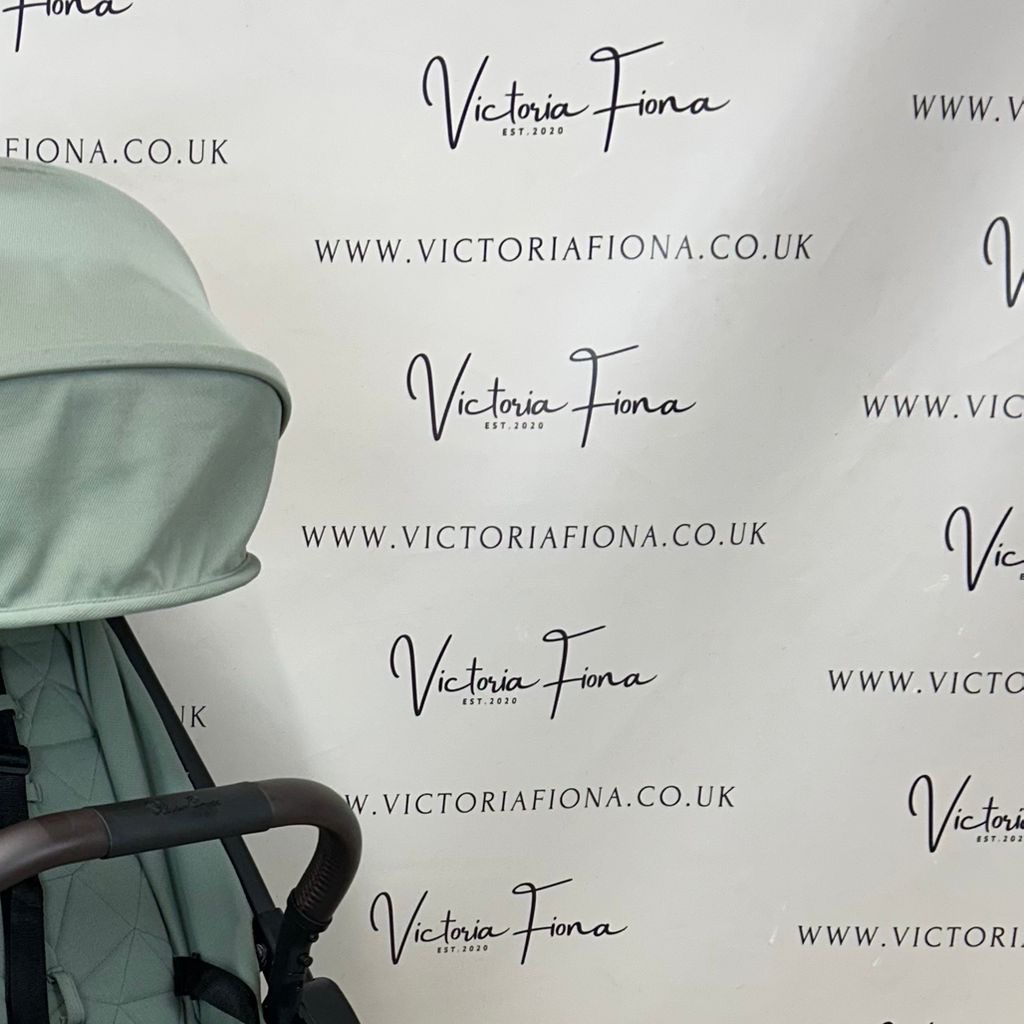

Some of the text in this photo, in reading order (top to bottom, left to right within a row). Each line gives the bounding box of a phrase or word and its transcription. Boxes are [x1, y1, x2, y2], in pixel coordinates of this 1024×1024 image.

[422, 41, 730, 153] Victoria Fiona
[502, 127, 563, 136] EST.2020
[315, 234, 813, 263] WWW.VICTORIAFIONA.CO.UK
[407, 345, 696, 448] Victoria Fiona
[301, 522, 767, 549] WWW.VICTORIAFIONA.CO.UK
[390, 625, 657, 720] Victoria Fiona
[462, 697, 517, 705] EST.2020
[908, 775, 1024, 853] Victori
[370, 878, 628, 965] Victoria Fiona
[437, 944, 488, 953] EST.2020
[798, 925, 1024, 948] WWW.VICTORI
